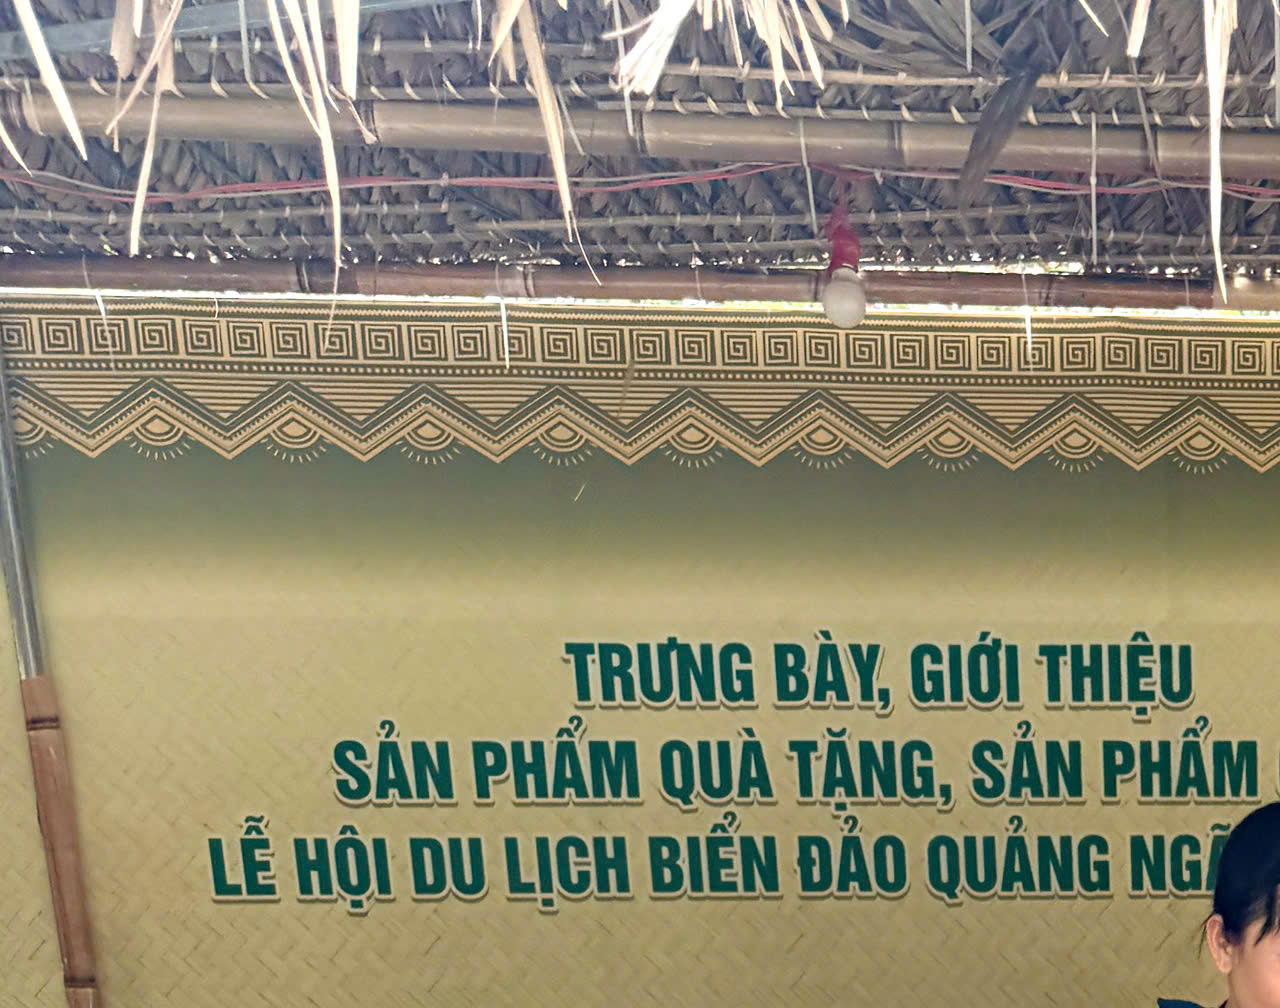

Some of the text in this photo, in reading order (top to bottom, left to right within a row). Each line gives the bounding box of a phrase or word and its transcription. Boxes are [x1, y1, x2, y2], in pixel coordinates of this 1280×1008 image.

[564, 629, 1194, 717] TRƯNG BÀY, GIỚI THIỆU
[333, 719, 454, 802] SẢN
[472, 715, 640, 801] PHẨM
[658, 728, 774, 810] QUÀ
[787, 727, 953, 812] TẶNG,
[969, 720, 1083, 801] SẢN
[1102, 716, 1259, 800] PHẨM
[207, 815, 277, 897] LỄ
[294, 824, 393, 911] HỘI
[410, 837, 488, 897] DU
[505, 836, 632, 909] LỊCH
[648, 811, 779, 896] BIỂN
[798, 815, 907, 896] ĐẢO
[927, 814, 1111, 903] QUẢNG
